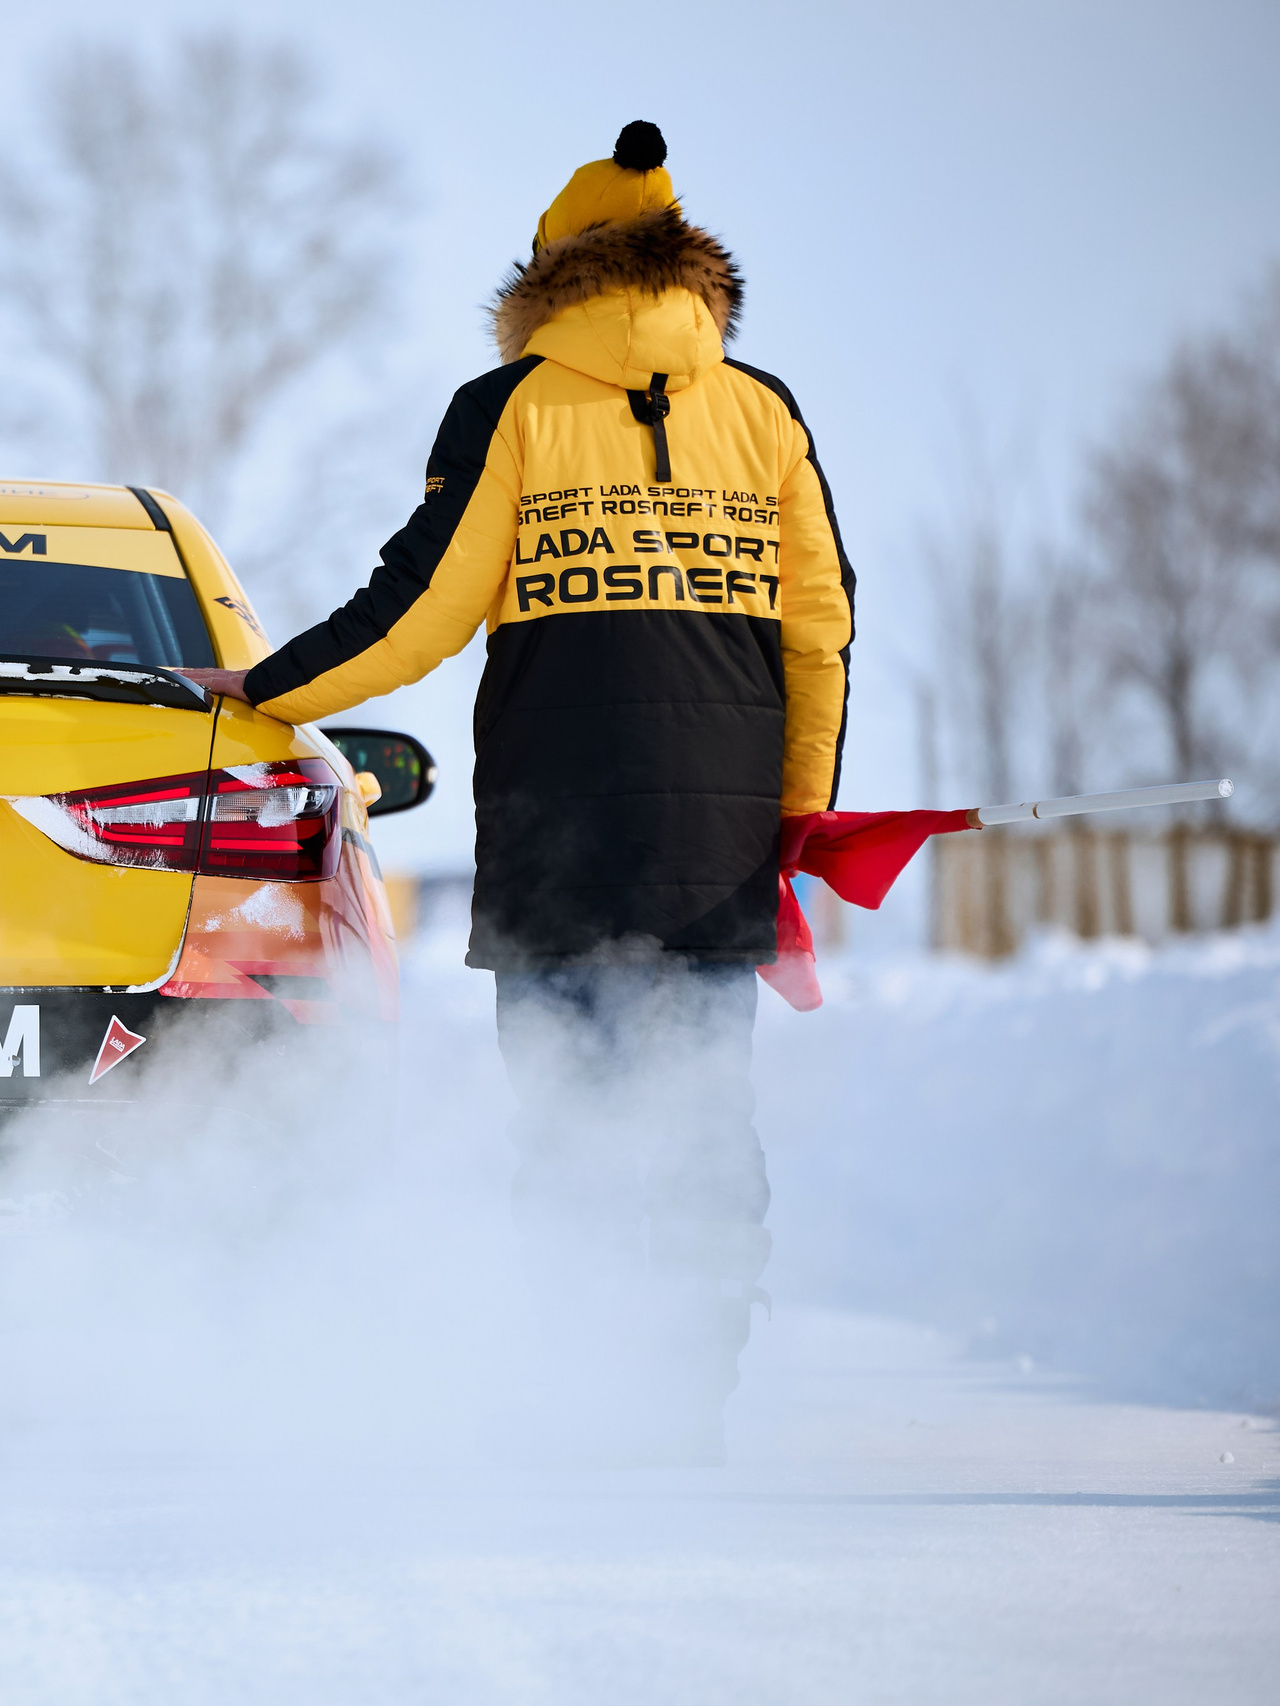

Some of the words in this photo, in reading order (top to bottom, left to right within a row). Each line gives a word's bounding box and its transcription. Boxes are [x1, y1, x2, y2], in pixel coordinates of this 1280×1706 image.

[521, 487, 593, 506] SPORT
[600, 485, 641, 497] LADA
[647, 486, 717, 499] SPORT
[723, 490, 759, 505] LADA
[601, 500, 717, 518] ROSNEFT
[515, 527, 615, 565] LADA
[633, 530, 780, 564] SPORT
[516, 564, 780, 612] ROSNEFT
